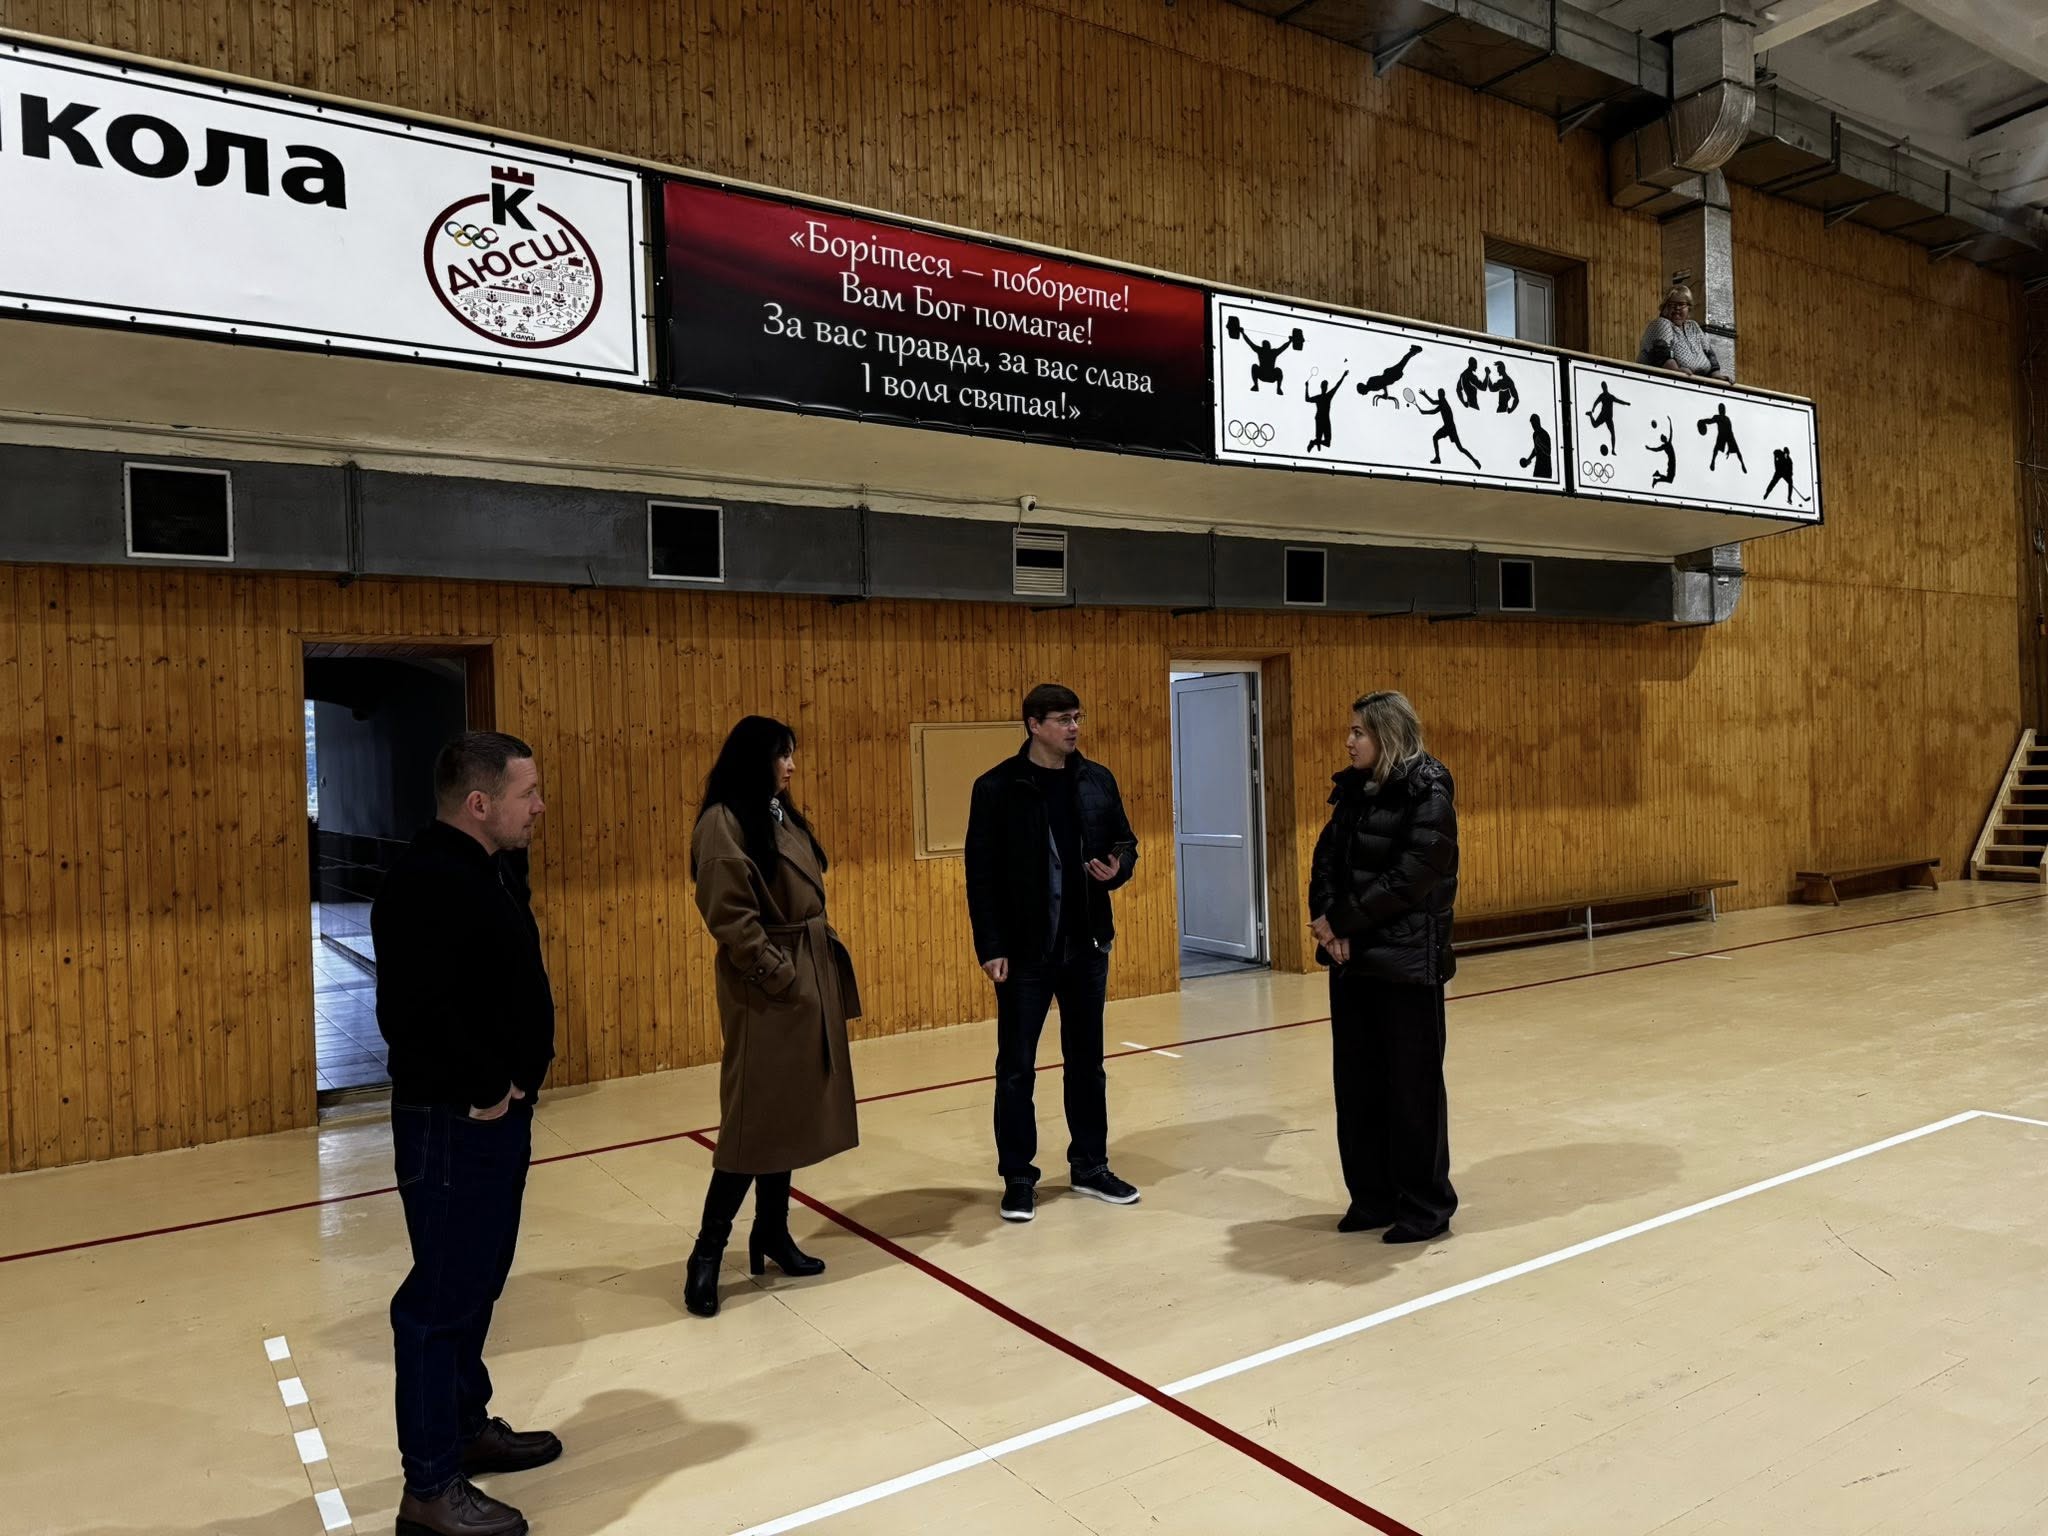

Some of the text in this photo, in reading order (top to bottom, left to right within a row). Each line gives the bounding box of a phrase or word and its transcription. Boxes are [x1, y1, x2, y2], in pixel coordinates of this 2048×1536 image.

[0, 92, 347, 209] кола
[447, 229, 576, 296] ДЮСШ
[789, 220, 954, 280] «Борітеся
[991, 264, 1129, 313] поборете!
[762, 302, 1155, 395] За вас правда, за вас слава
[838, 271, 1093, 346] Вам Бог помагає!
[860, 362, 1082, 421] І воля святая!»
